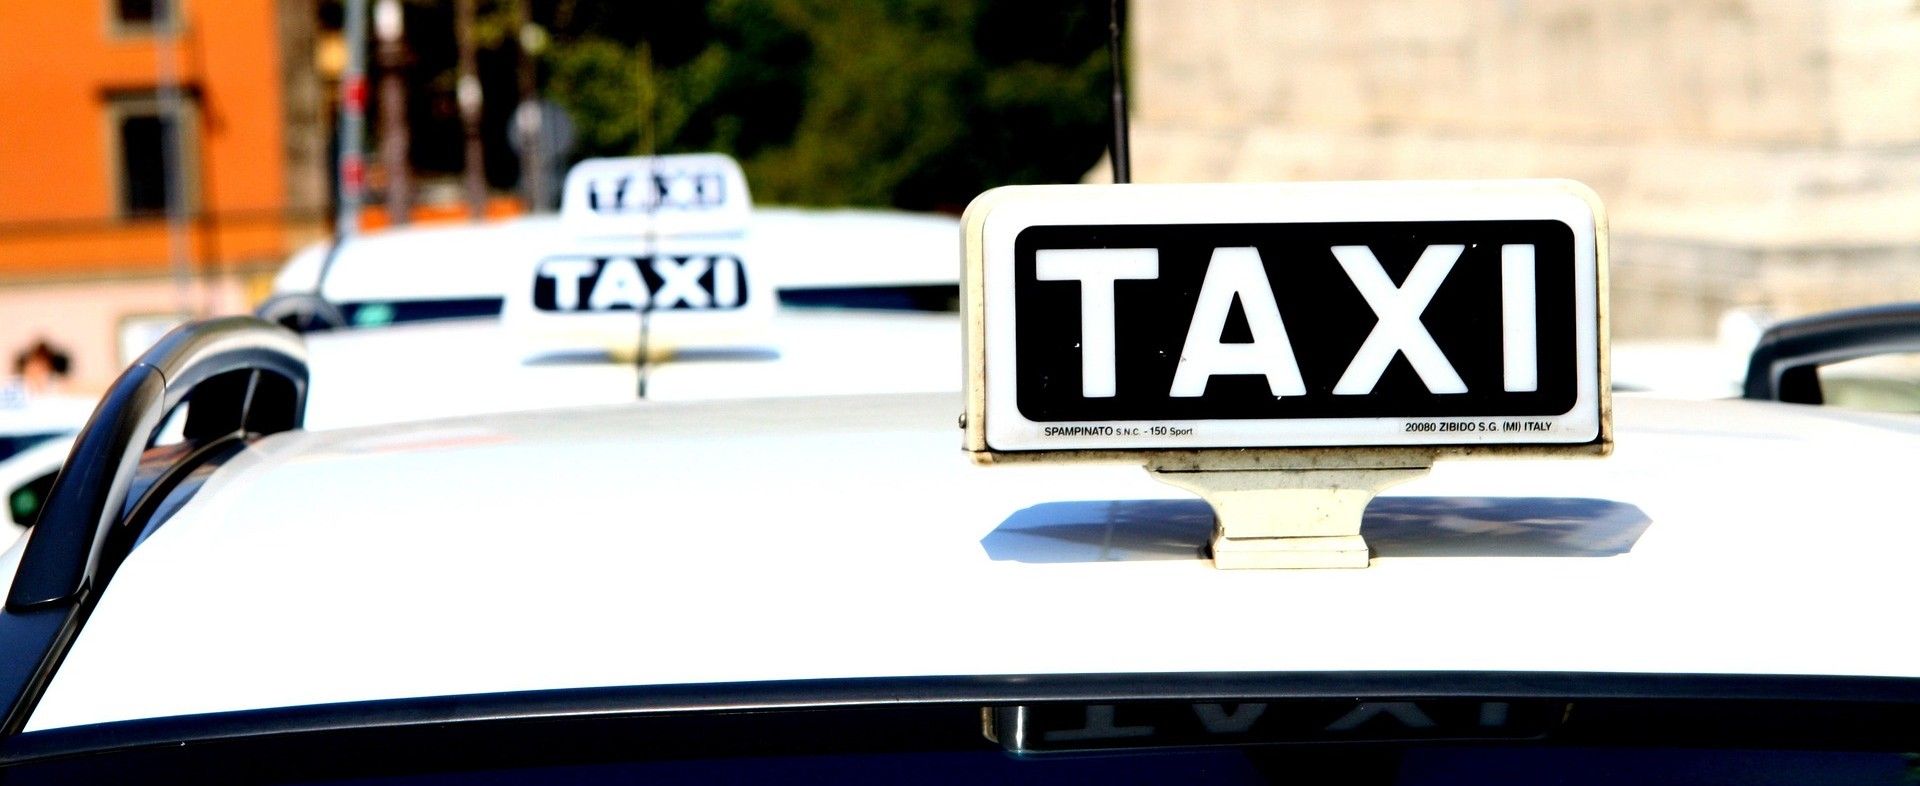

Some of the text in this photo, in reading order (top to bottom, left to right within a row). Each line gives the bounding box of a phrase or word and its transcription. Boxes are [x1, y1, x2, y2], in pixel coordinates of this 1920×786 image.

[539, 256, 739, 310] TAXI
[1035, 243, 1538, 398] TAXI
[1044, 426, 1113, 436] SPAMPINATO
[1149, 426, 1167, 436] 150
[1169, 427, 1193, 437] Sport
[1405, 421, 1552, 432] 20080 ZIBIDO S.G. (MI) ITALY
